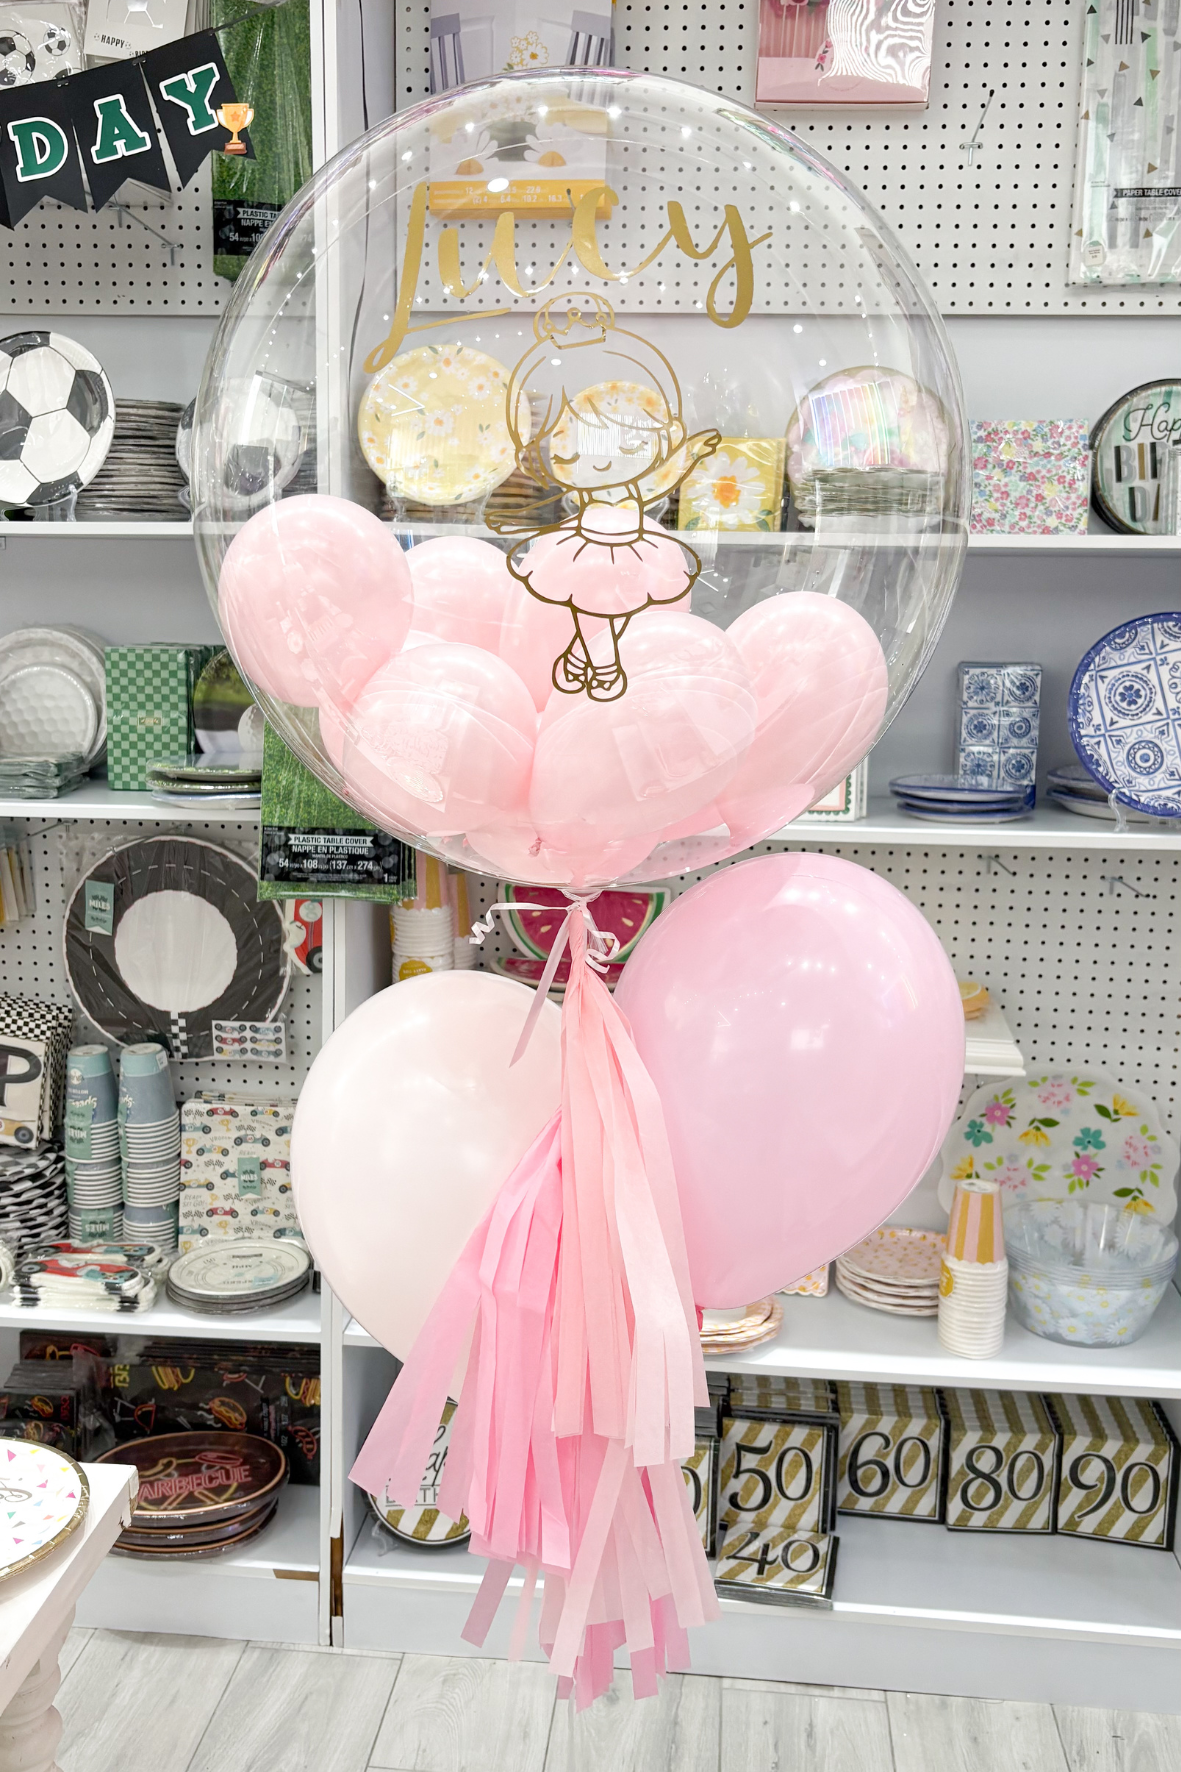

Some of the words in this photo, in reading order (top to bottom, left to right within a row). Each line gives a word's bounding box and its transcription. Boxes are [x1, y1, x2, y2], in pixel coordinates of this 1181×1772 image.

[101, 34, 125, 49] HAPPY
[7, 62, 220, 182] DAY
[241, 218, 263, 227] NAPPE
[242, 209, 269, 219] PLASTIC
[229, 232, 239, 242] 54
[363, 181, 774, 375] Lucy
[292, 845, 316, 853] NAPPE
[317, 845, 328, 853] EN
[329, 846, 369, 855] PLASTIQUE
[293, 836, 321, 844] PLASTIC
[323, 836, 344, 845] TABLE
[345, 837, 368, 845] COVER
[279, 858, 289, 868] 54
[303, 859, 318, 869] 108
[357, 860, 373, 870] 274
[383, 873, 388, 883] 1
[728, 1440, 813, 1512] 50
[847, 1431, 931, 1499] 60
[138, 1465, 252, 1501] ARBECUE
[959, 1444, 1045, 1512] 80
[1069, 1453, 1161, 1520] 90
[725, 1531, 820, 1576] 40
